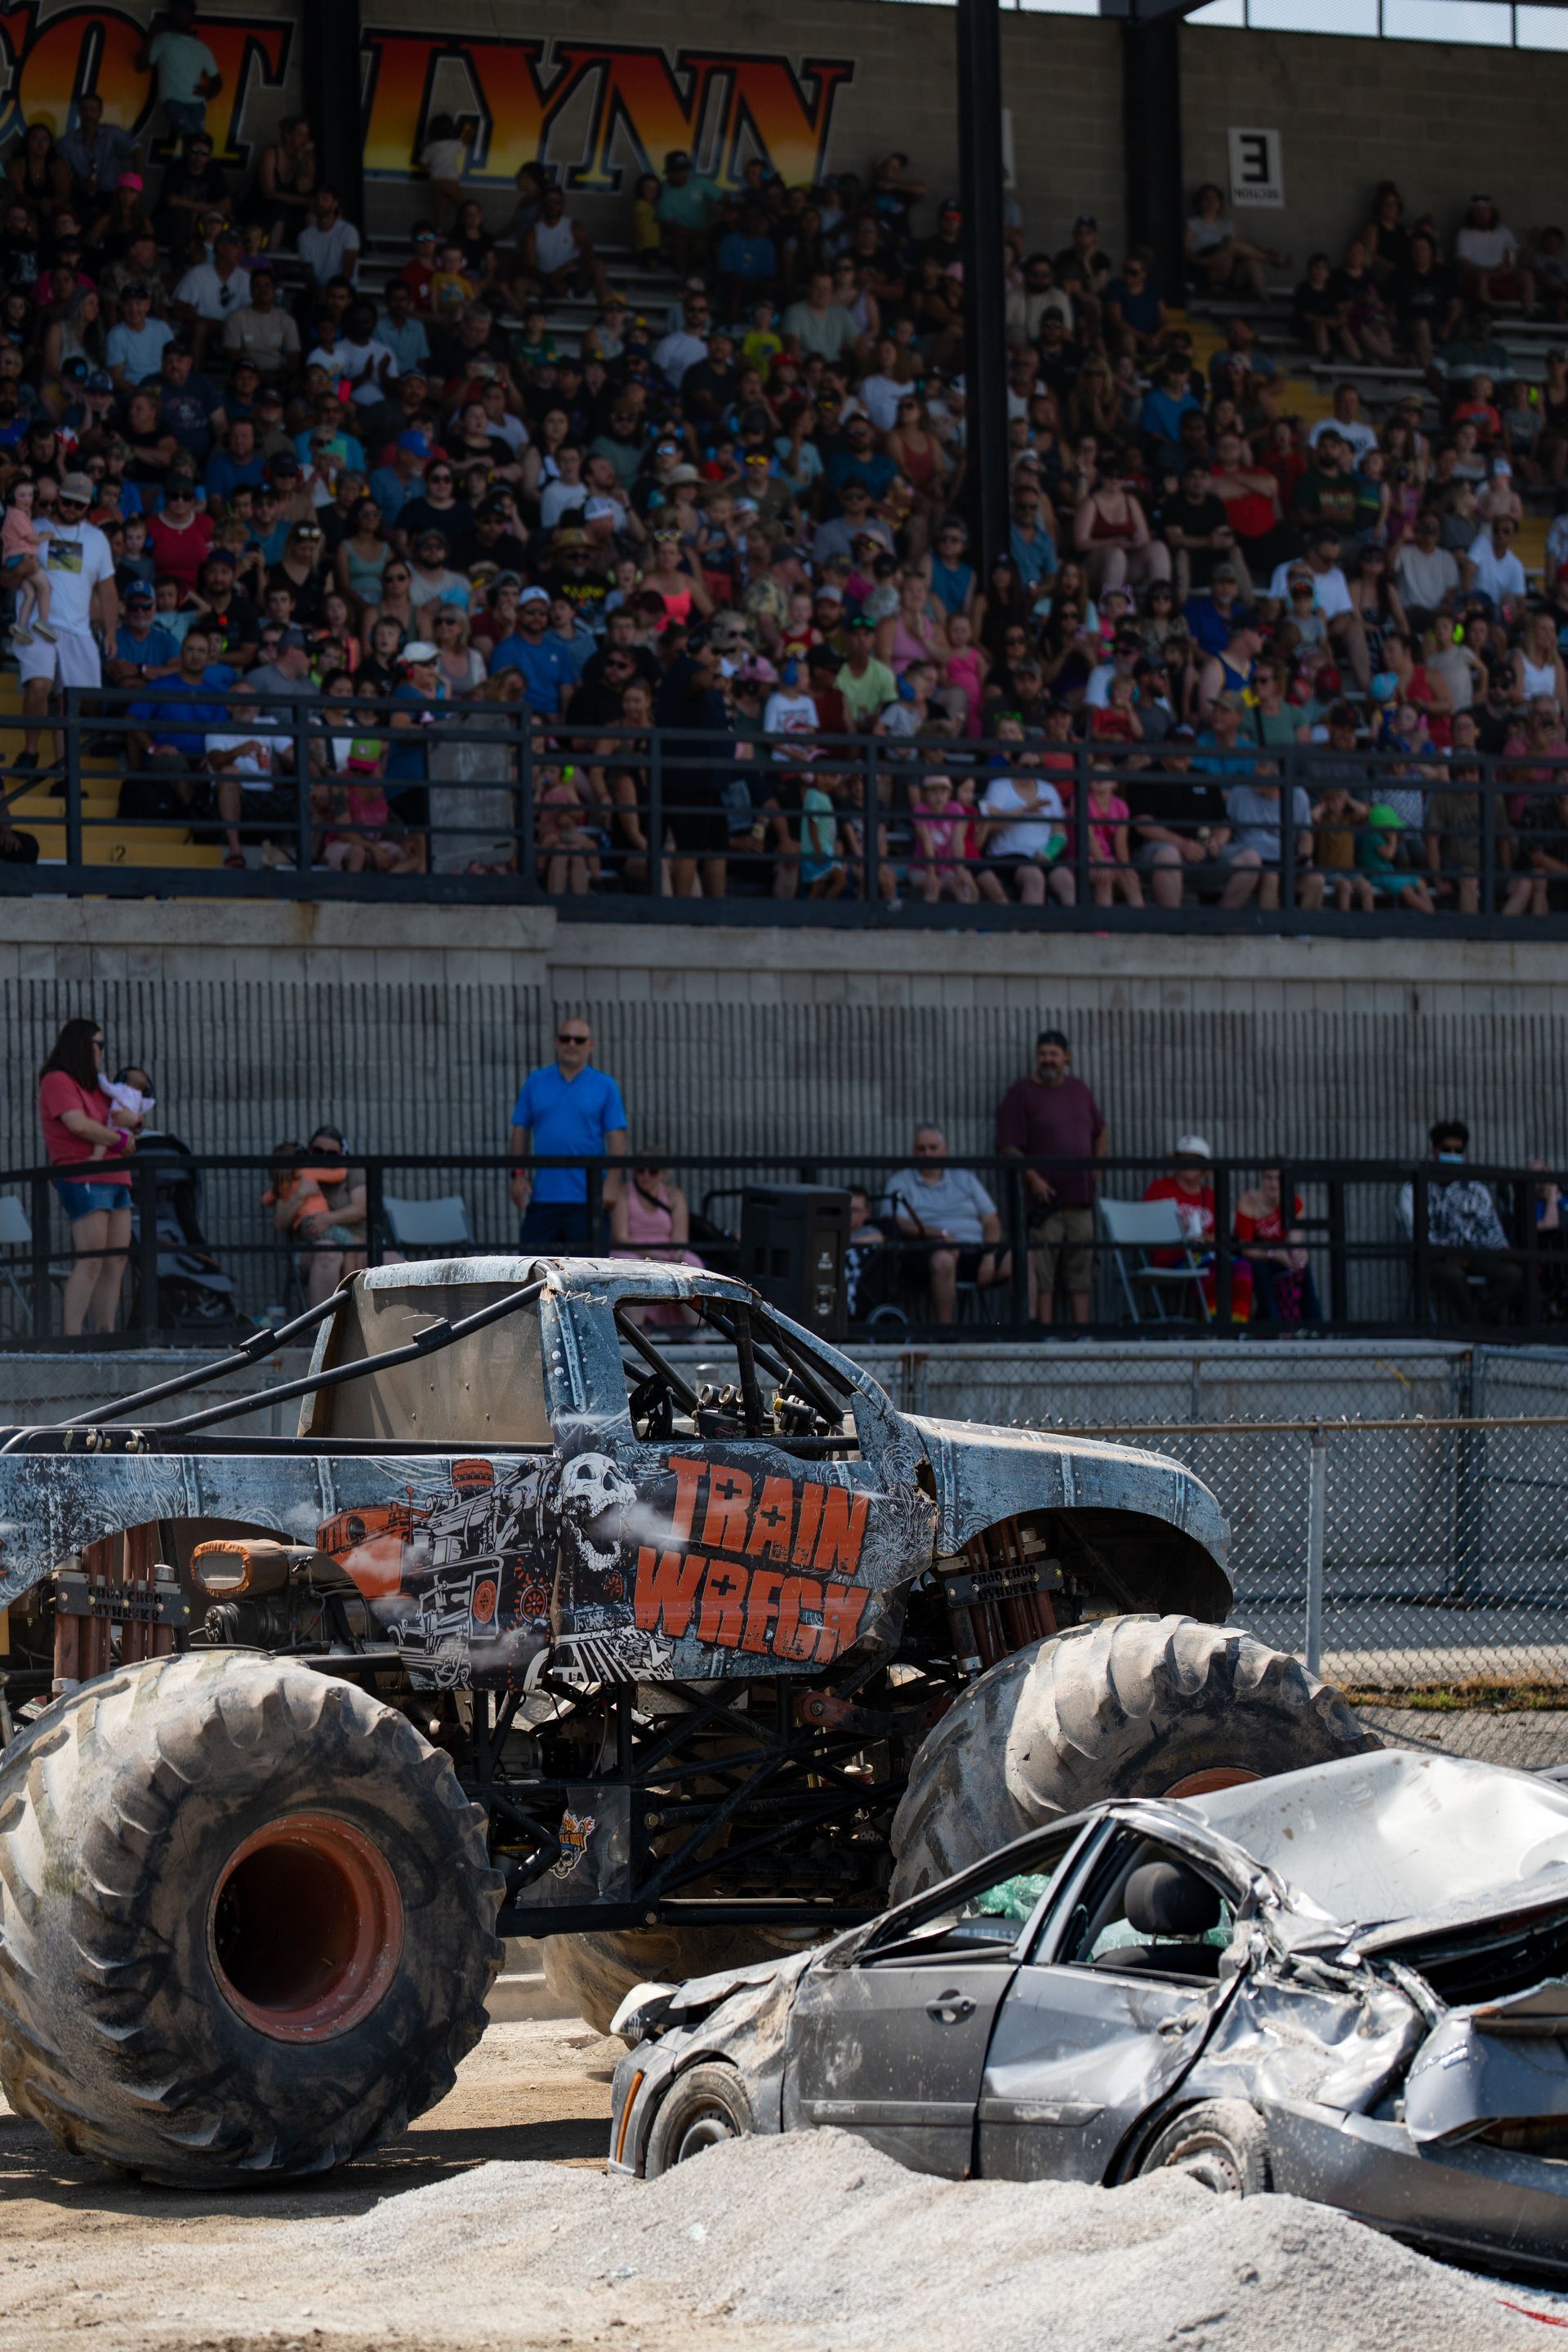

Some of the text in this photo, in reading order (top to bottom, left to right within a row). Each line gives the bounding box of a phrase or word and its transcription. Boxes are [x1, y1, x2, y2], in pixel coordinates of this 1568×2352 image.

[360, 28, 855, 193] LYNN
[1234, 187, 1279, 199] SECTION
[668, 1456, 870, 1575] TRAIN
[971, 1564, 1036, 1585] CHOO CHOO
[88, 1586, 163, 1604] CHOO CHOO
[634, 1545, 870, 1664] WRECK
[570, 1833, 584, 1849] OUT
